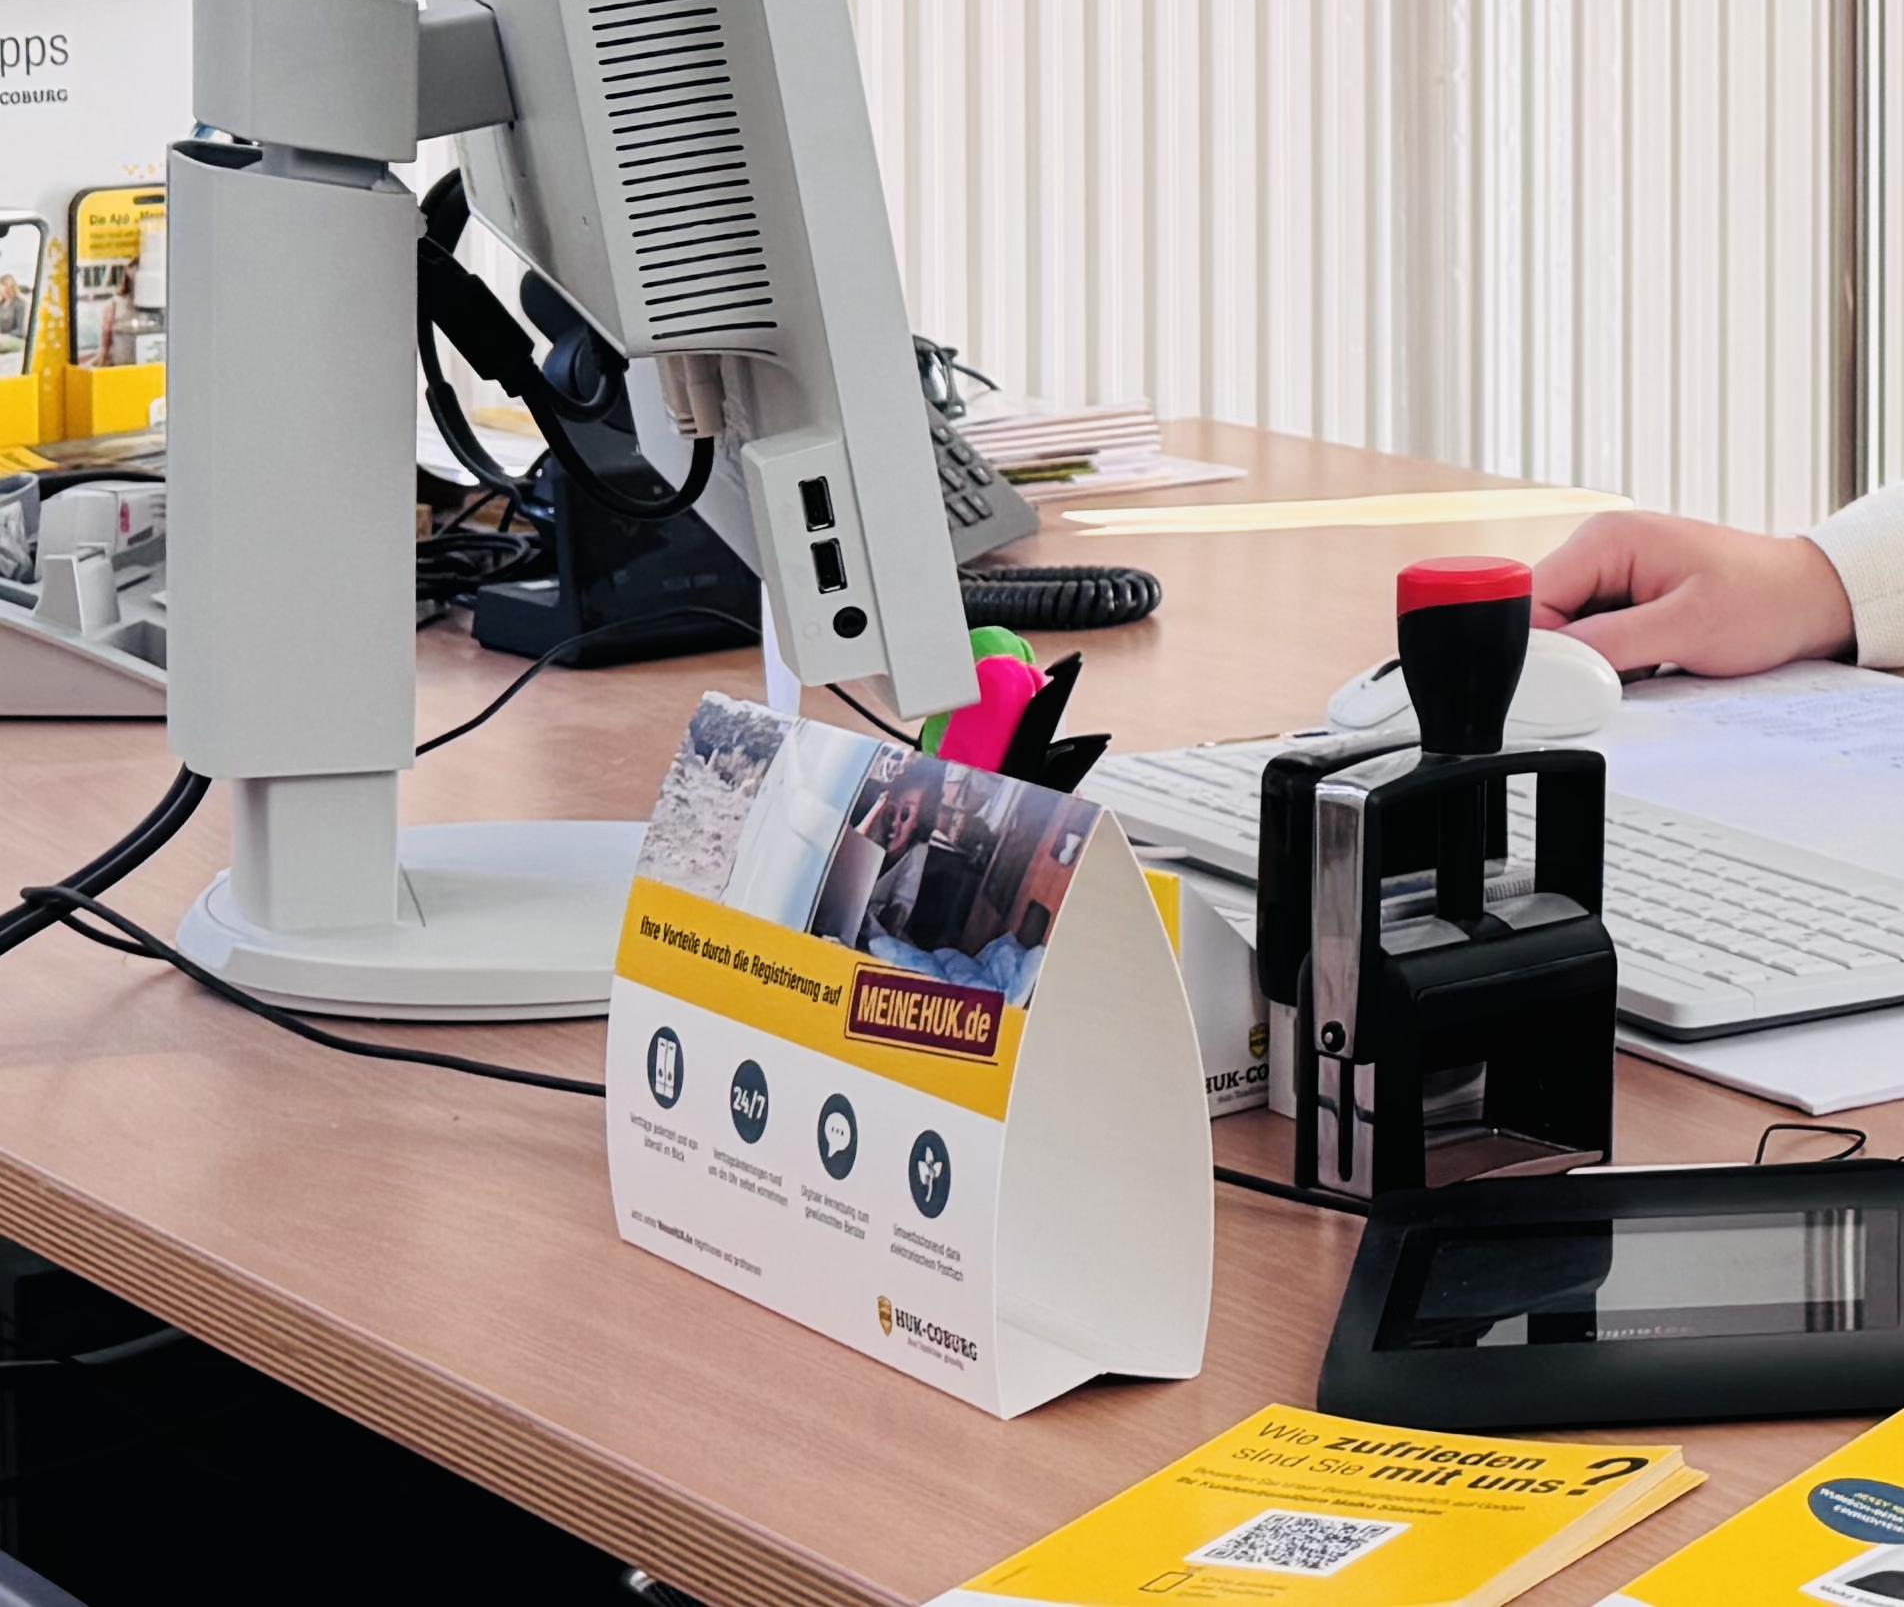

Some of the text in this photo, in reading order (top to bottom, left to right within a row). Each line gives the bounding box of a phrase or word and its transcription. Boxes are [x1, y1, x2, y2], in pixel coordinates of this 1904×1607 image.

[640, 915, 843, 1006] Ihre Vorteile durch die Registrierung auf
[857, 985, 991, 1042] MEINEHUK.de
[732, 1086, 766, 1119] 24/7
[1232, 1447, 1310, 1469] sind
[1309, 1457, 1366, 1476] Sie
[1368, 1464, 1463, 1487] mit
[1258, 1421, 1547, 1471] Wie zufrieden
